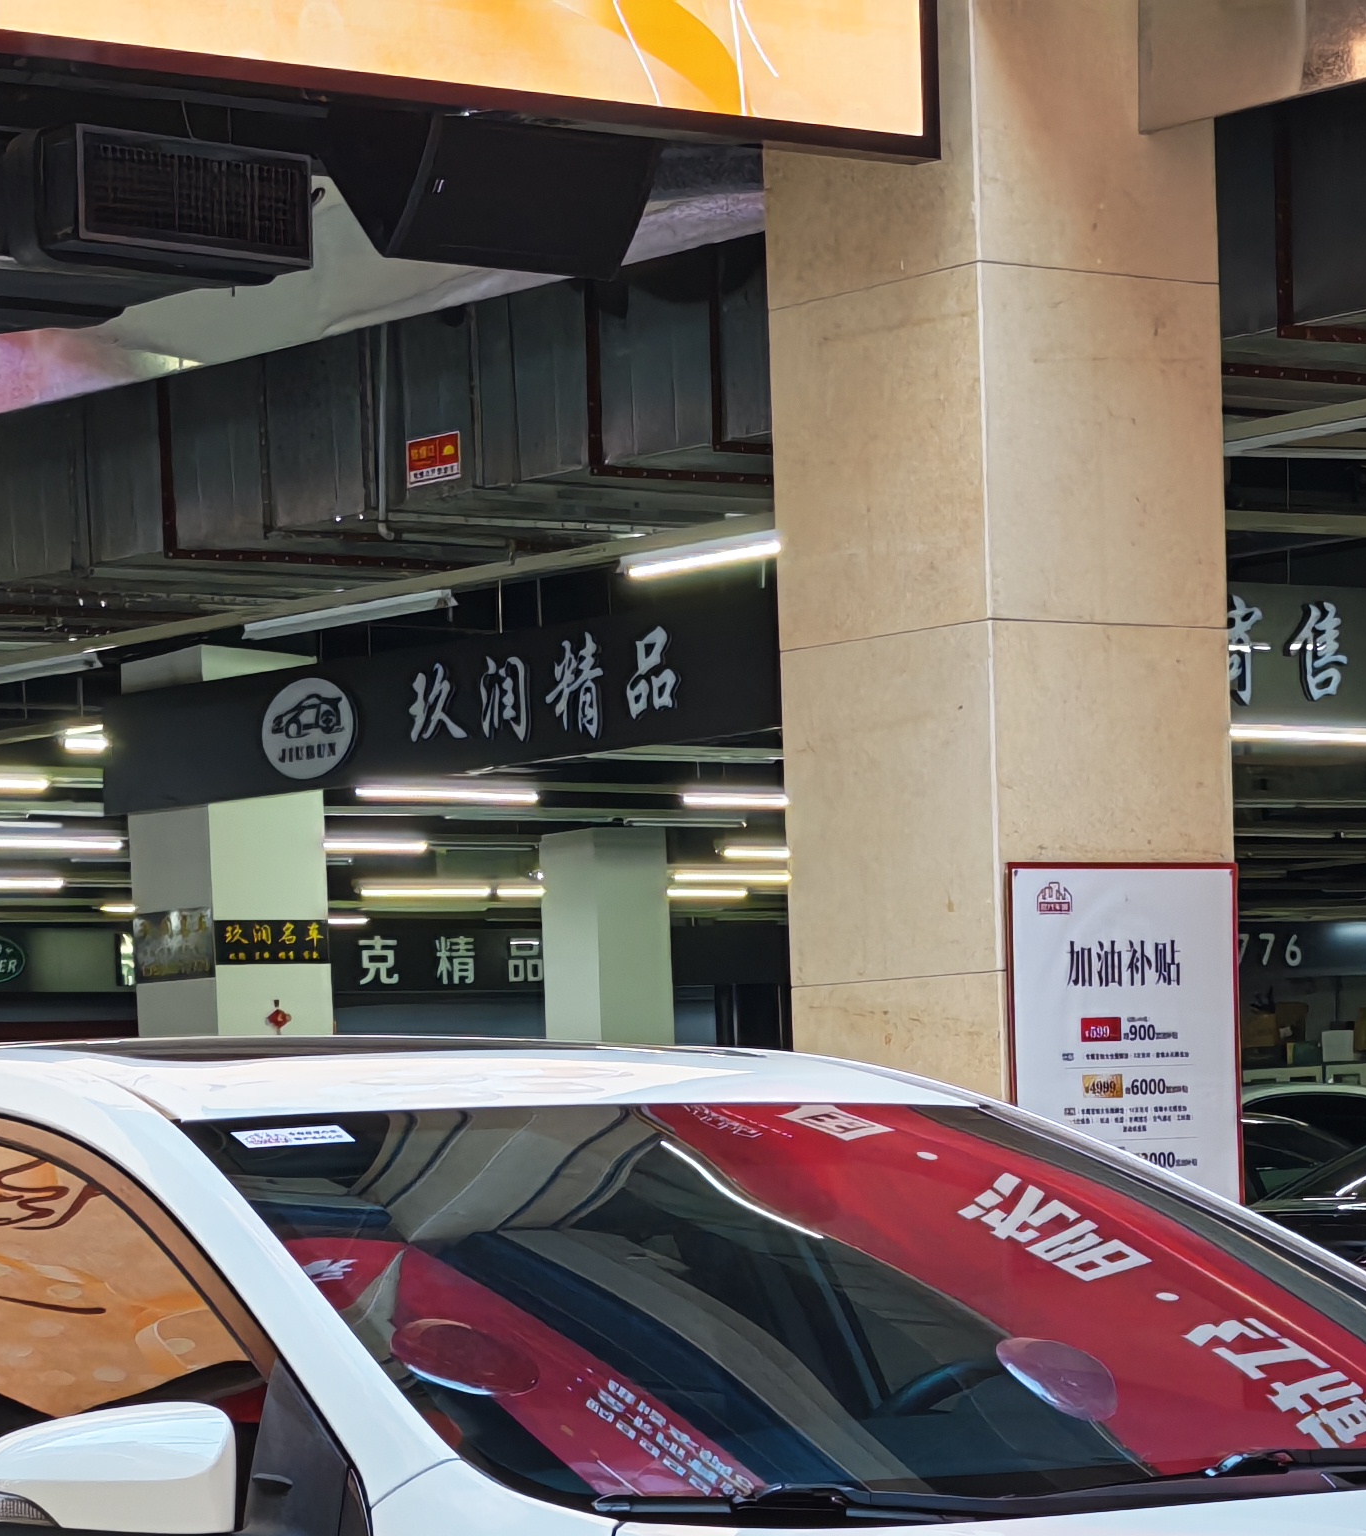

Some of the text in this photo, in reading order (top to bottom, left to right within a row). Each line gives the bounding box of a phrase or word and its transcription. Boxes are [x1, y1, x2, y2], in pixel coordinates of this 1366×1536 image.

[408, 624, 680, 744] 玖润精品
[224, 921, 326, 946] 玖润名车
[357, 935, 544, 986] 克精品
[1065, 938, 1182, 988] 加油补贴
